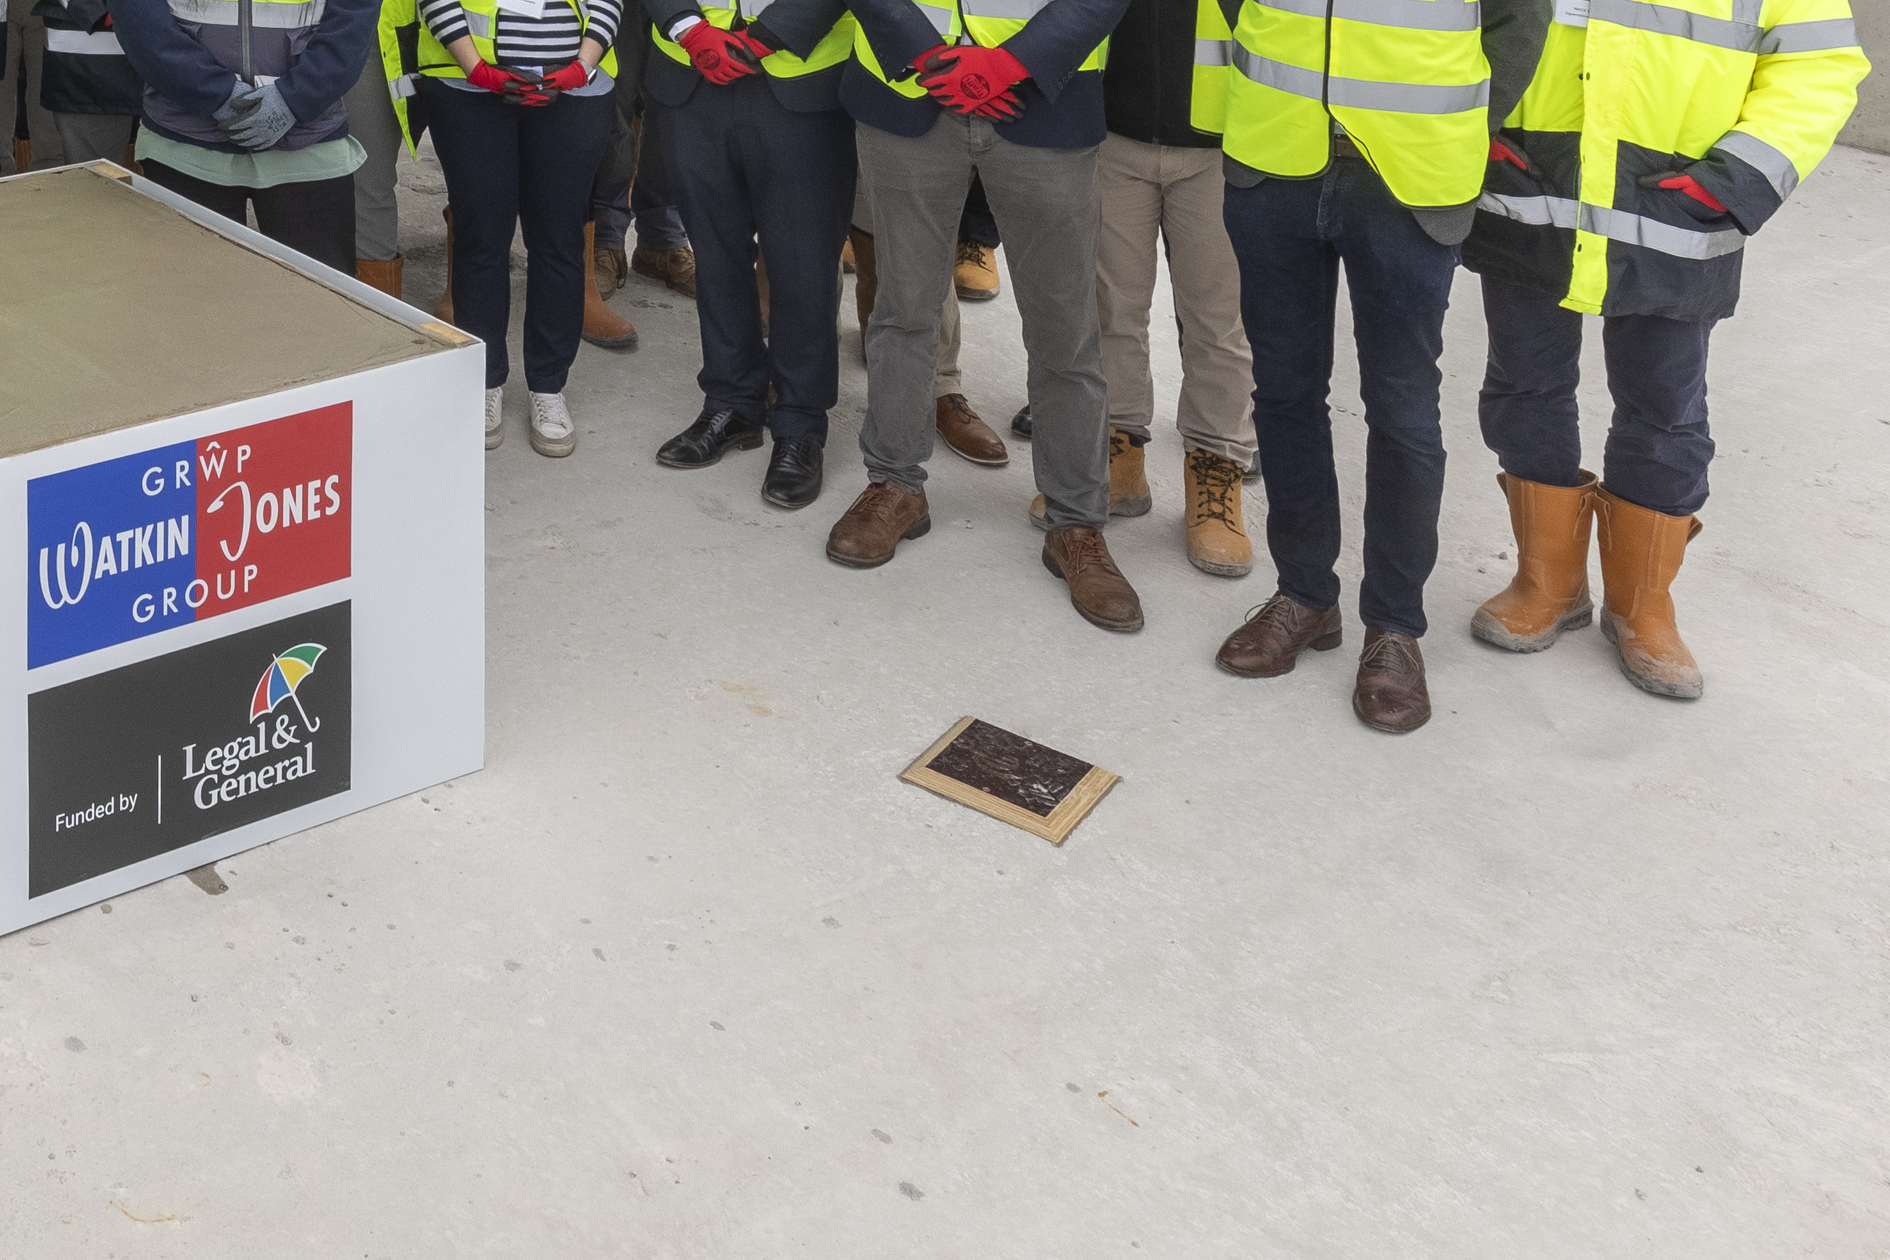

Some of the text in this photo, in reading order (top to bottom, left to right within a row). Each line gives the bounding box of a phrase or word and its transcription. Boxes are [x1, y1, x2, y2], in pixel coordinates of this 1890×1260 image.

[142, 441, 251, 497] GRŴP
[39, 475, 341, 610] WATKIN JONES
[132, 564, 258, 624] GROUP
[182, 714, 301, 781] Legal &
[193, 741, 316, 810] General
[55, 790, 138, 832] Funded by
